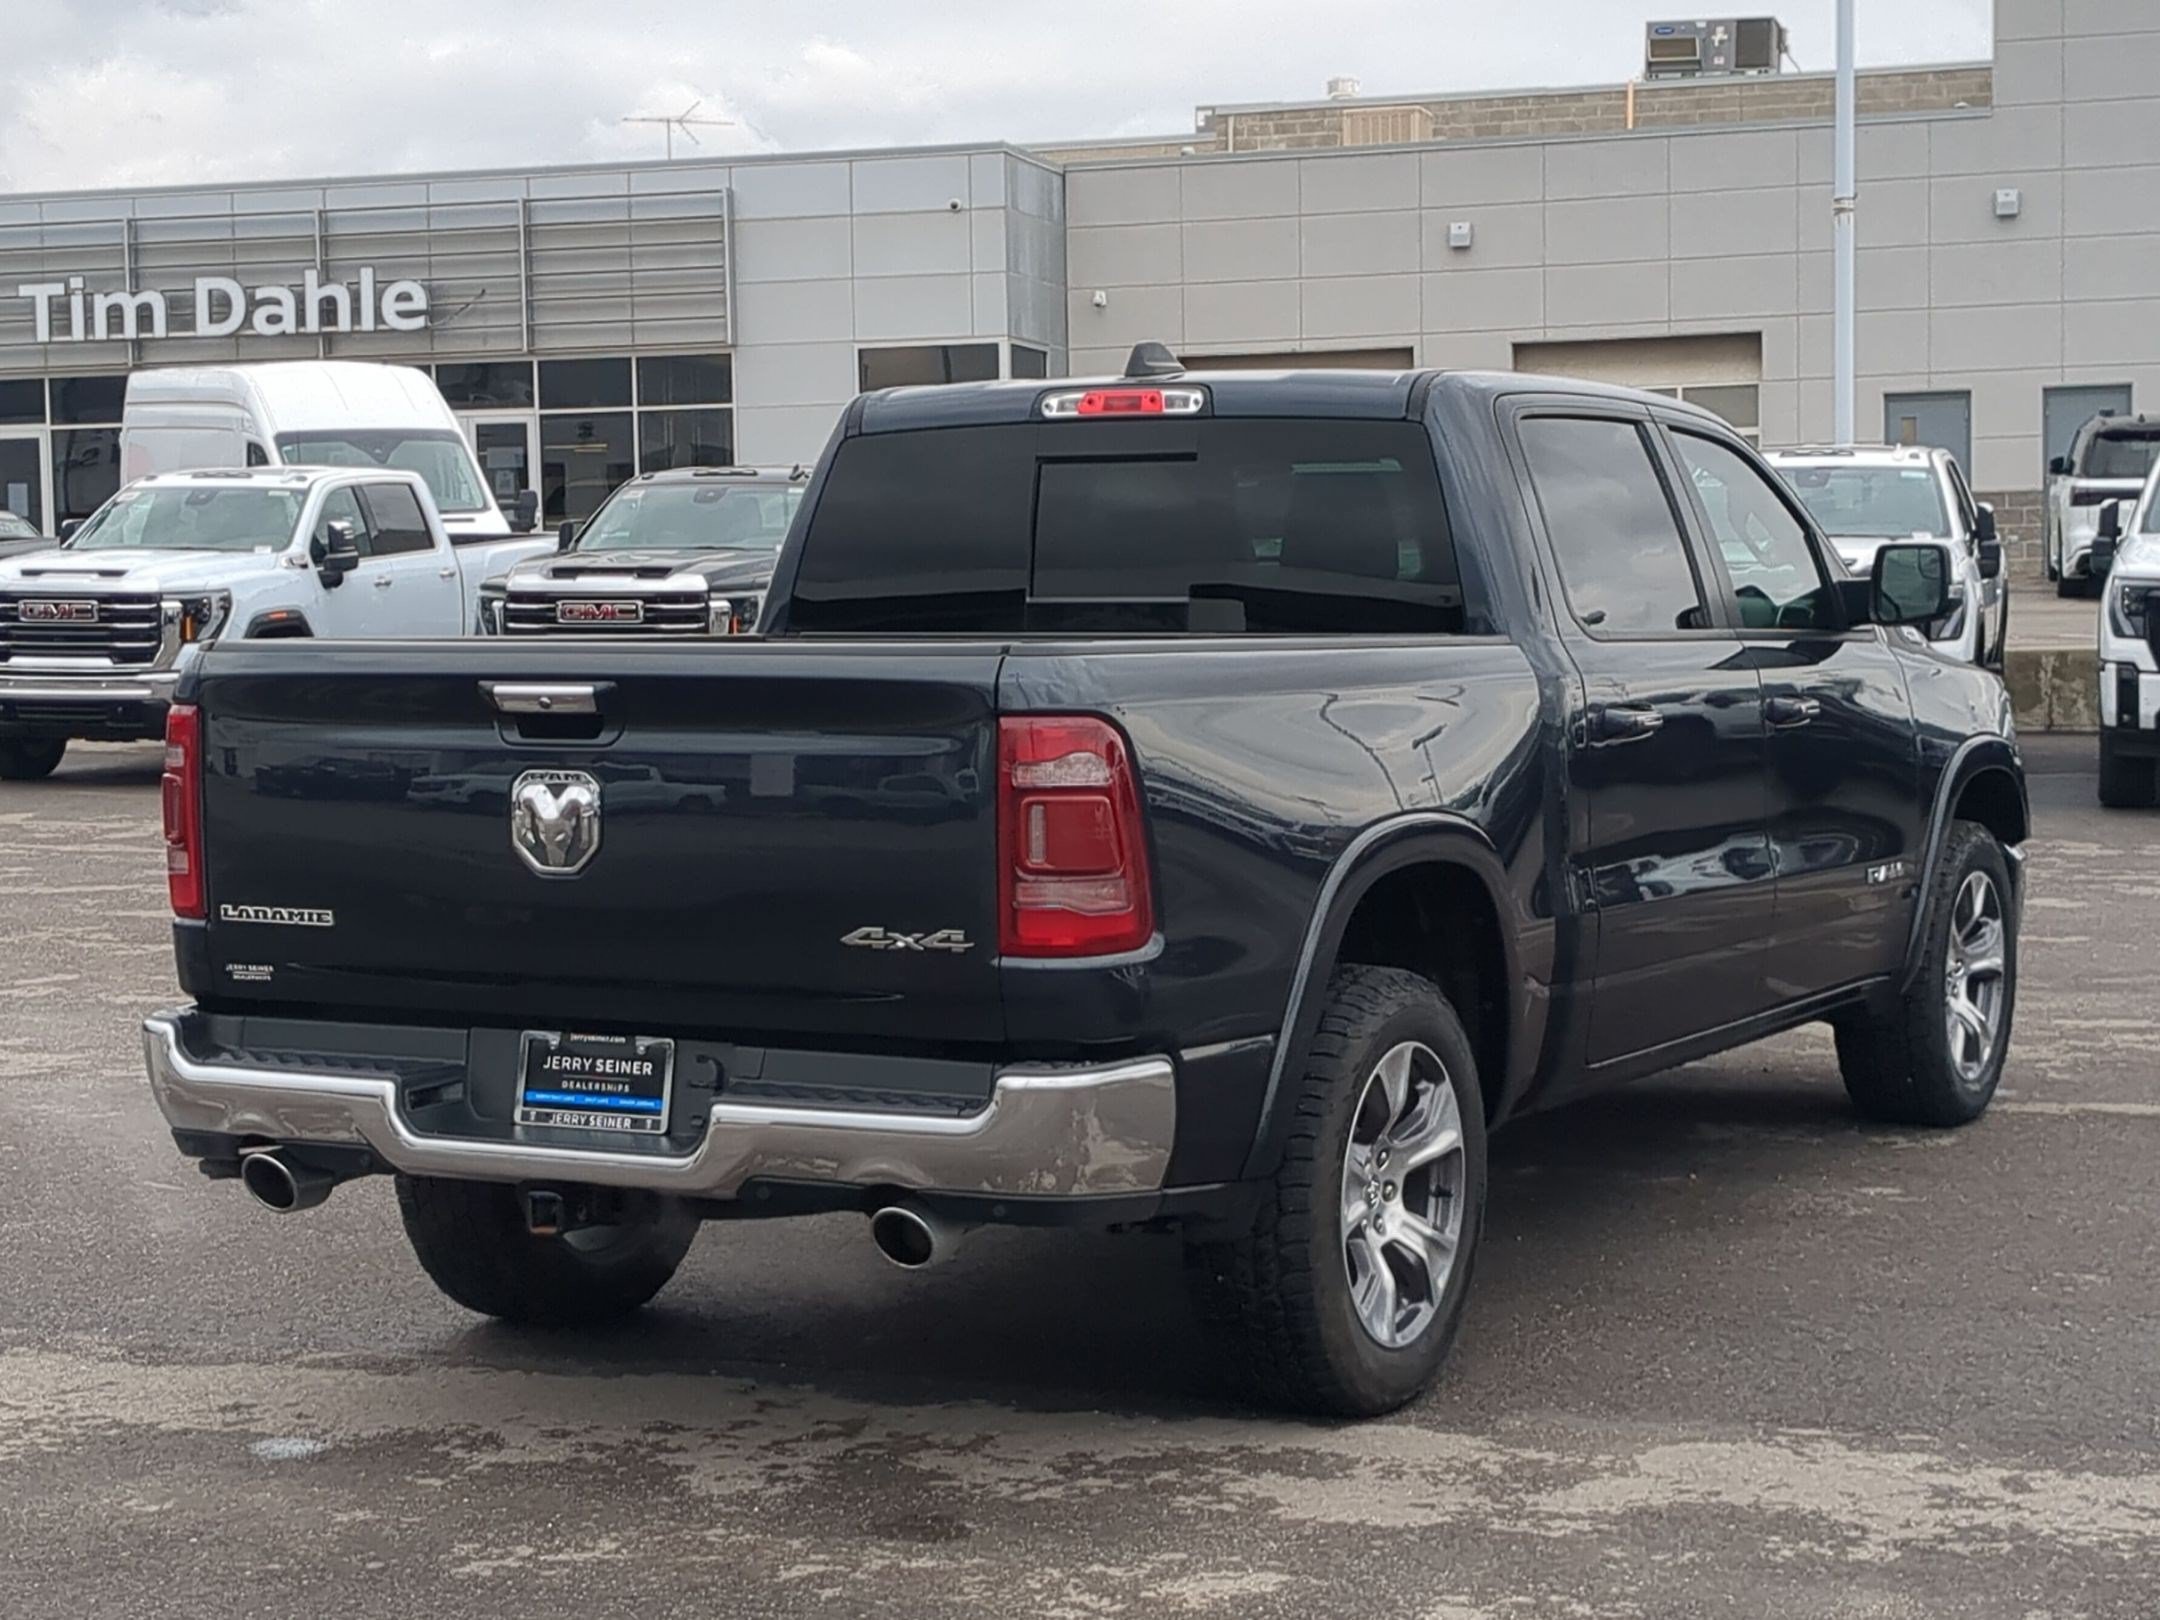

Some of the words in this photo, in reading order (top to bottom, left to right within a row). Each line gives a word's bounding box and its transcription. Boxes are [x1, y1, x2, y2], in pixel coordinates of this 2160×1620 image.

[18, 276, 168, 342] Tim
[194, 267, 429, 337] Dahle
[22, 603, 92, 619] GMC
[562, 603, 637, 620] GMC
[220, 904, 334, 926] LARAMIE
[543, 1055, 595, 1072] JERRY
[595, 1059, 653, 1076] SEINER
[561, 1080, 630, 1093] DEALERSHIPS
[549, 1112, 588, 1127] JERRY
[589, 1115, 632, 1129] SEINER
